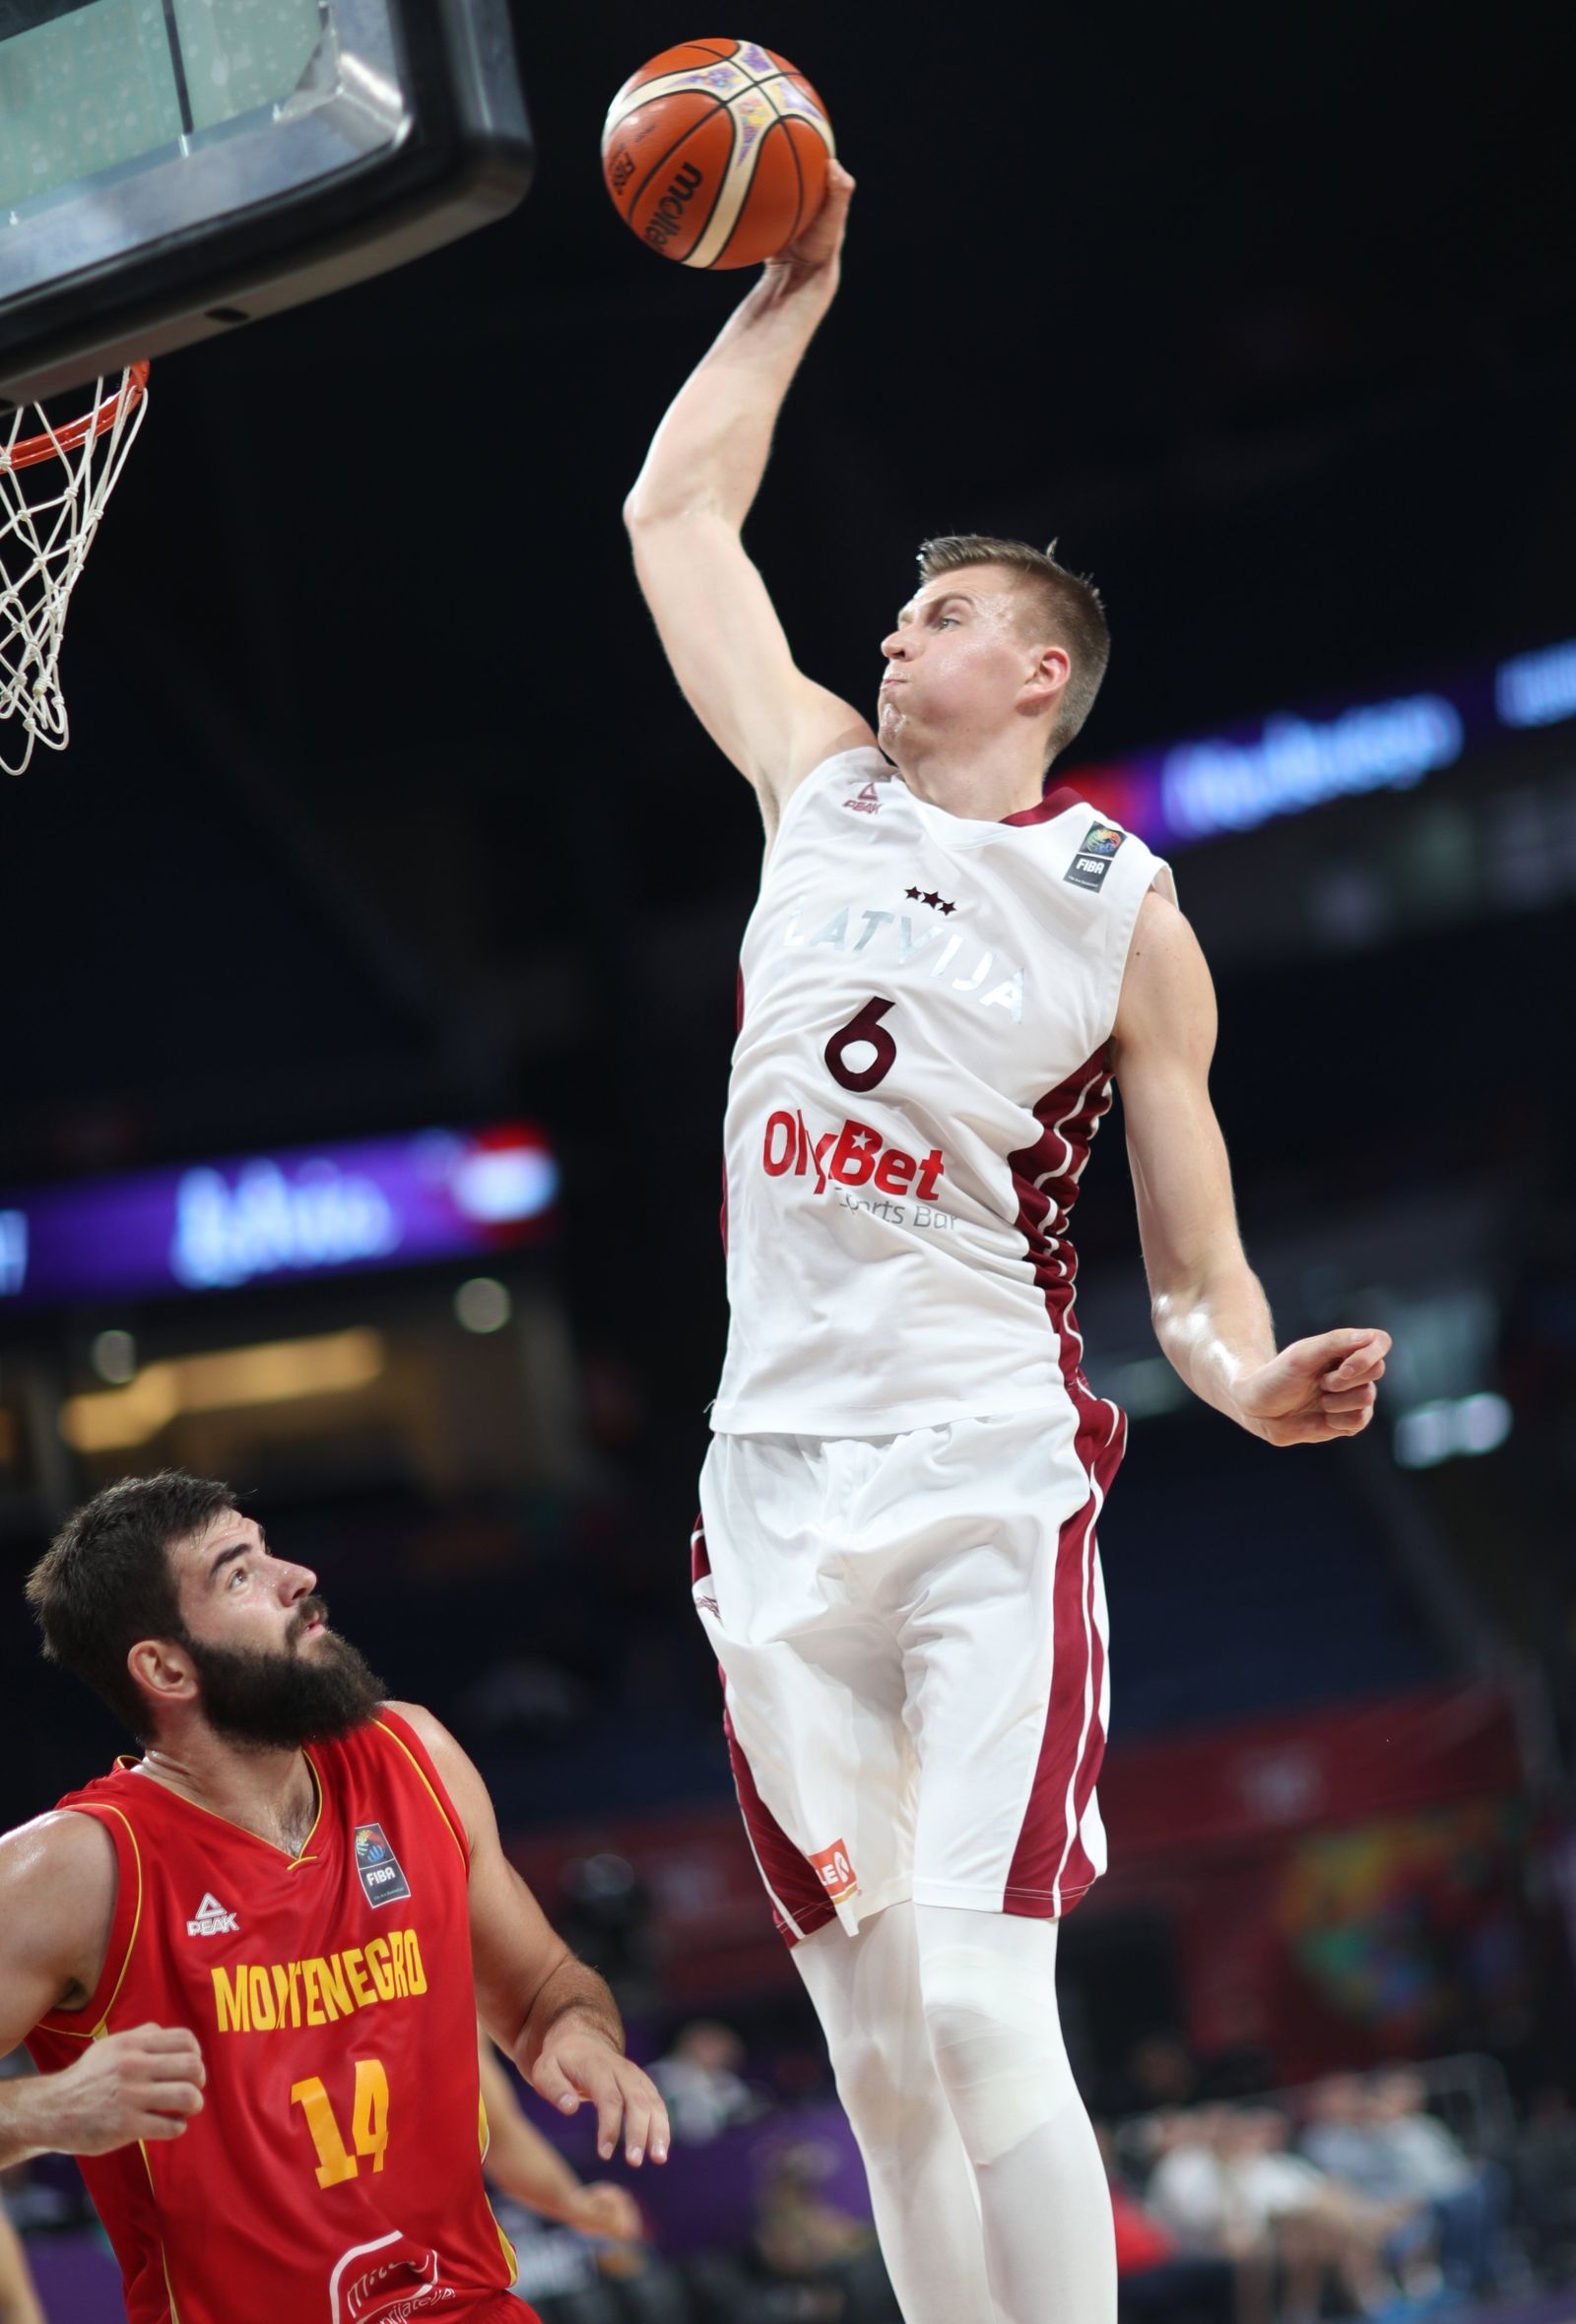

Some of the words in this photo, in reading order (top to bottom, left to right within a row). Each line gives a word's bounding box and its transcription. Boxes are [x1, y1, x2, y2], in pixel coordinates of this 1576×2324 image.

[842, 799, 885, 814] PEAK
[1076, 858, 1105, 874] FIBA
[784, 896, 1024, 1025] LATVIJA
[824, 996, 896, 1092] 6
[763, 1110, 944, 1200] OlyBet
[913, 1204, 957, 1230] Bar
[365, 1867, 396, 1886] FIBA
[187, 1912, 239, 1936] PEAK
[211, 1929, 427, 2033] MONTENEGRO
[291, 2059, 389, 2189] 14
